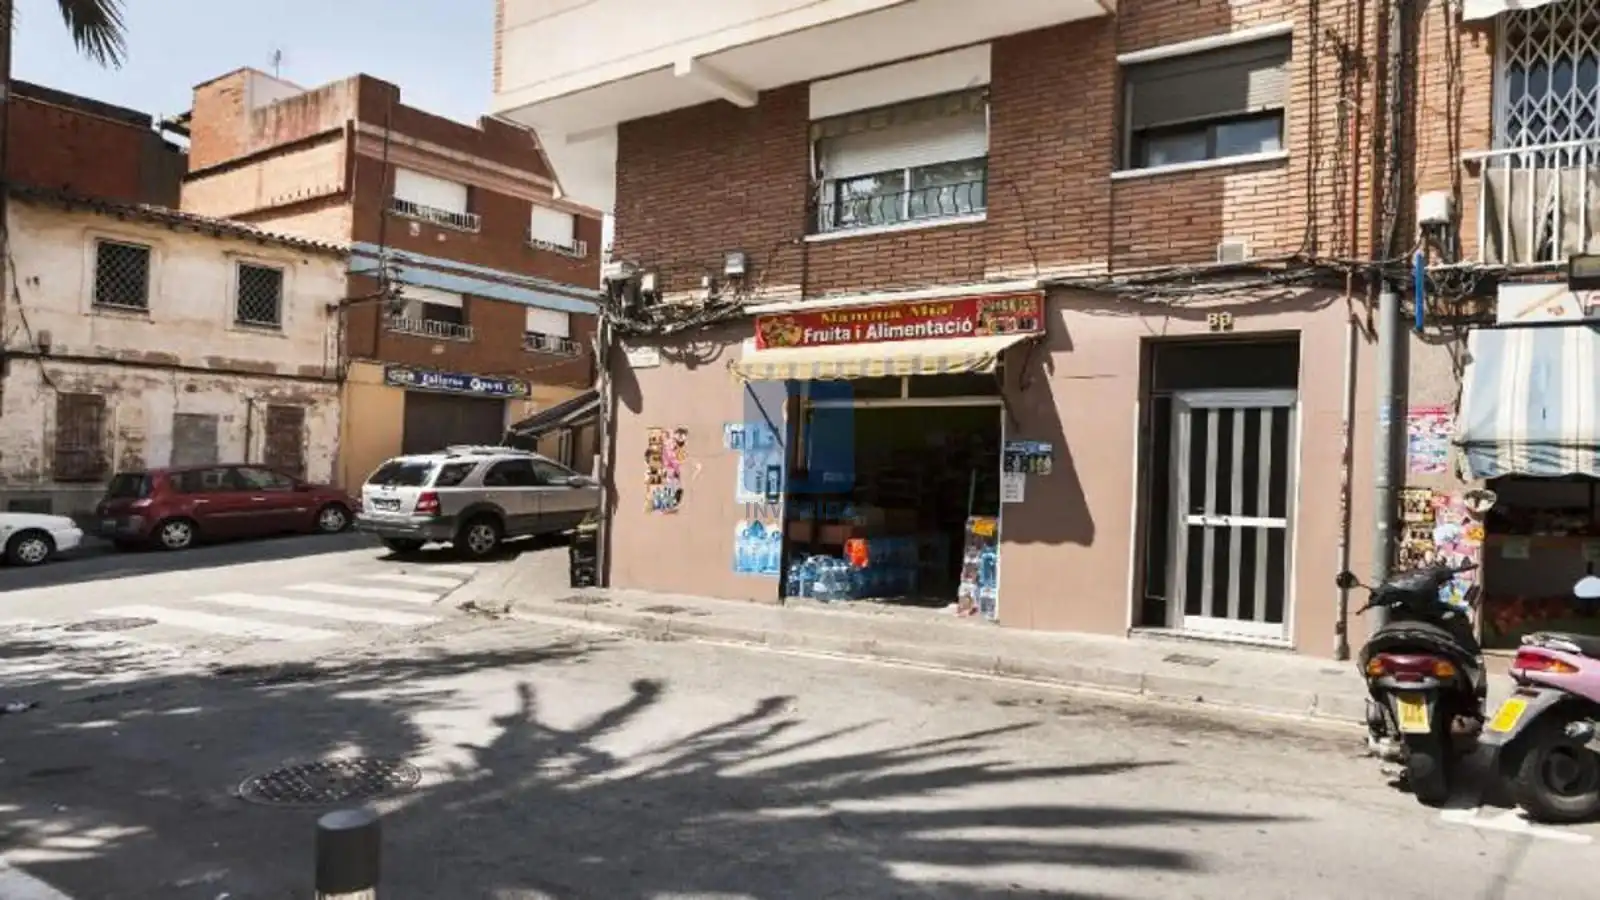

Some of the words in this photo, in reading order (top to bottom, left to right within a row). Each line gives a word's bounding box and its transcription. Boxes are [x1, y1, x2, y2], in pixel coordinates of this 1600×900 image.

[803, 326, 851, 344] Fruita
[855, 324, 861, 340] i
[866, 317, 973, 340] Alimentació
